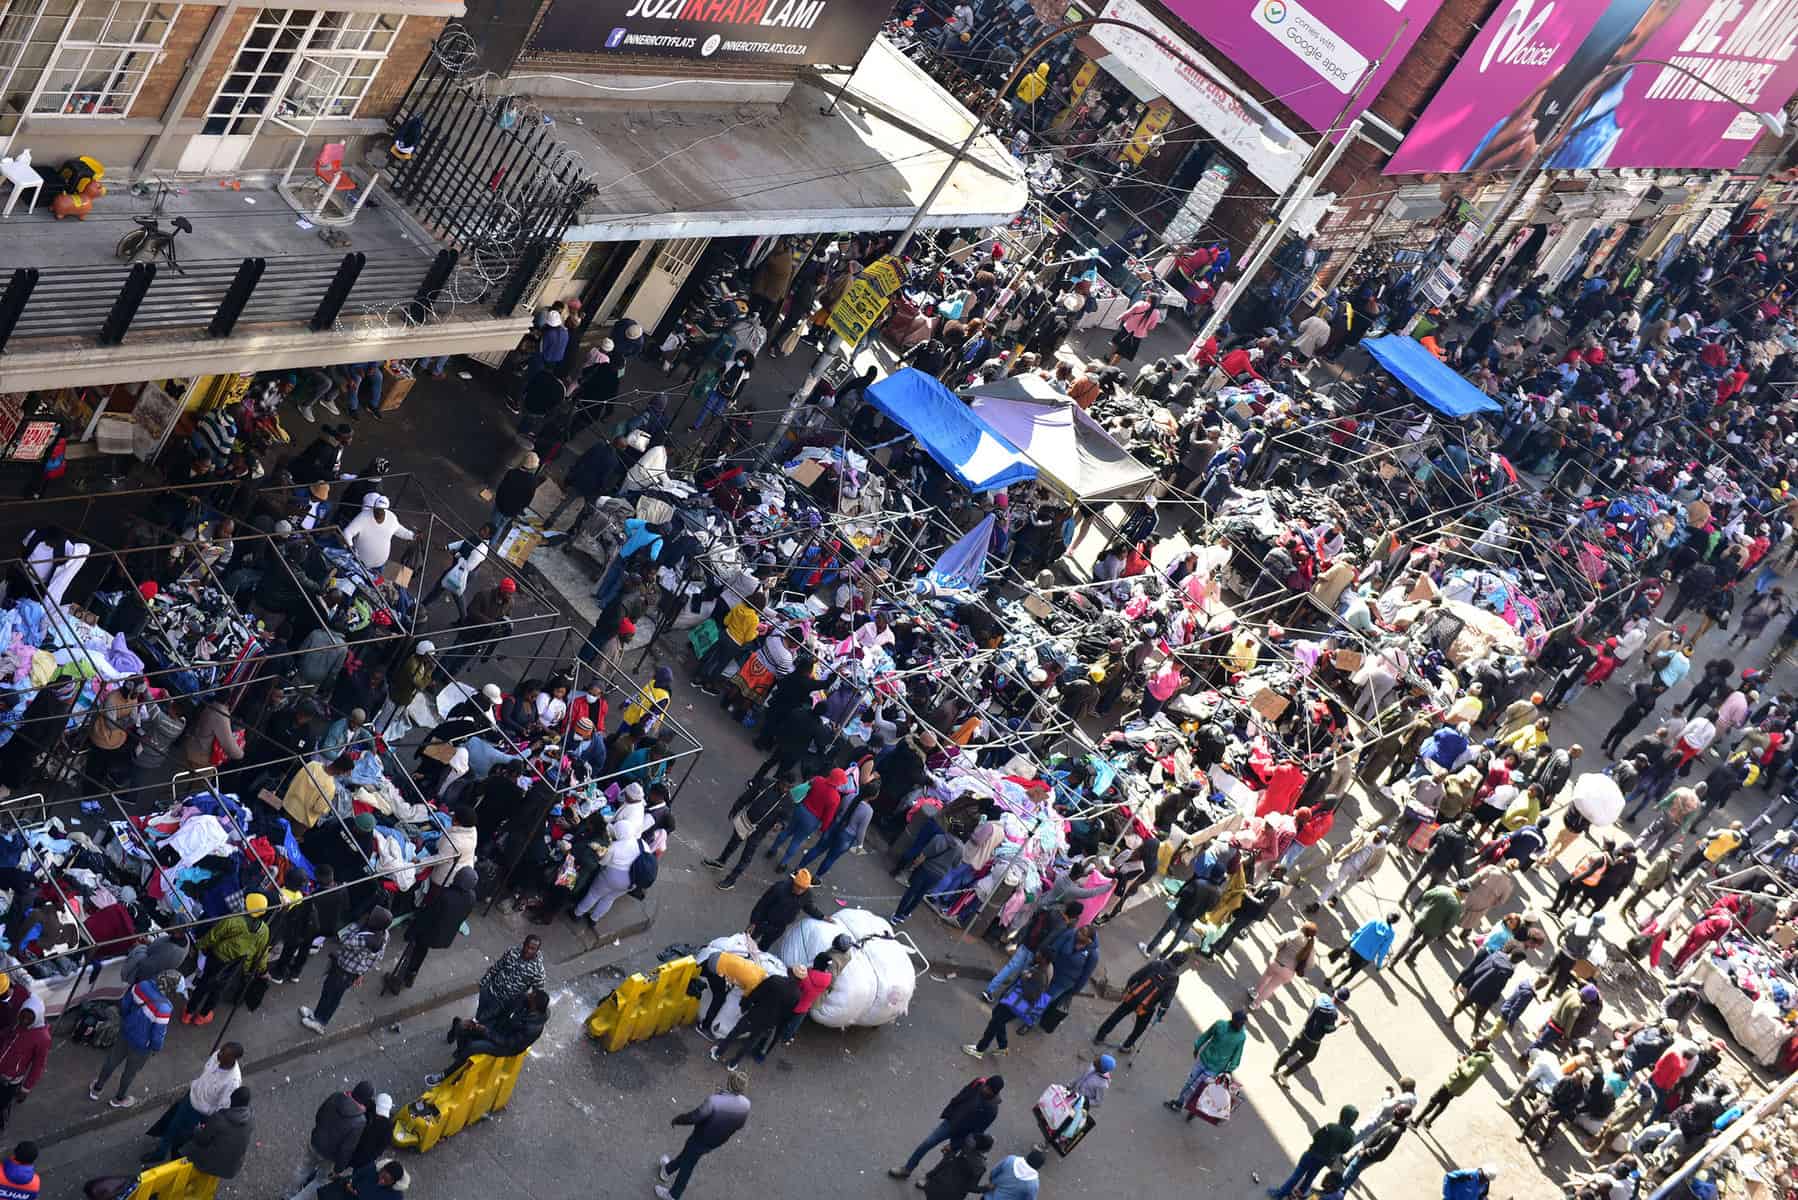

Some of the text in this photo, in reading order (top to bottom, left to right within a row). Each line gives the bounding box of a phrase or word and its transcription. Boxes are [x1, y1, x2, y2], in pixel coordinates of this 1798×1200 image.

[1286, 26, 1348, 81] Google apps
[1294, 16, 1336, 53] comes with
